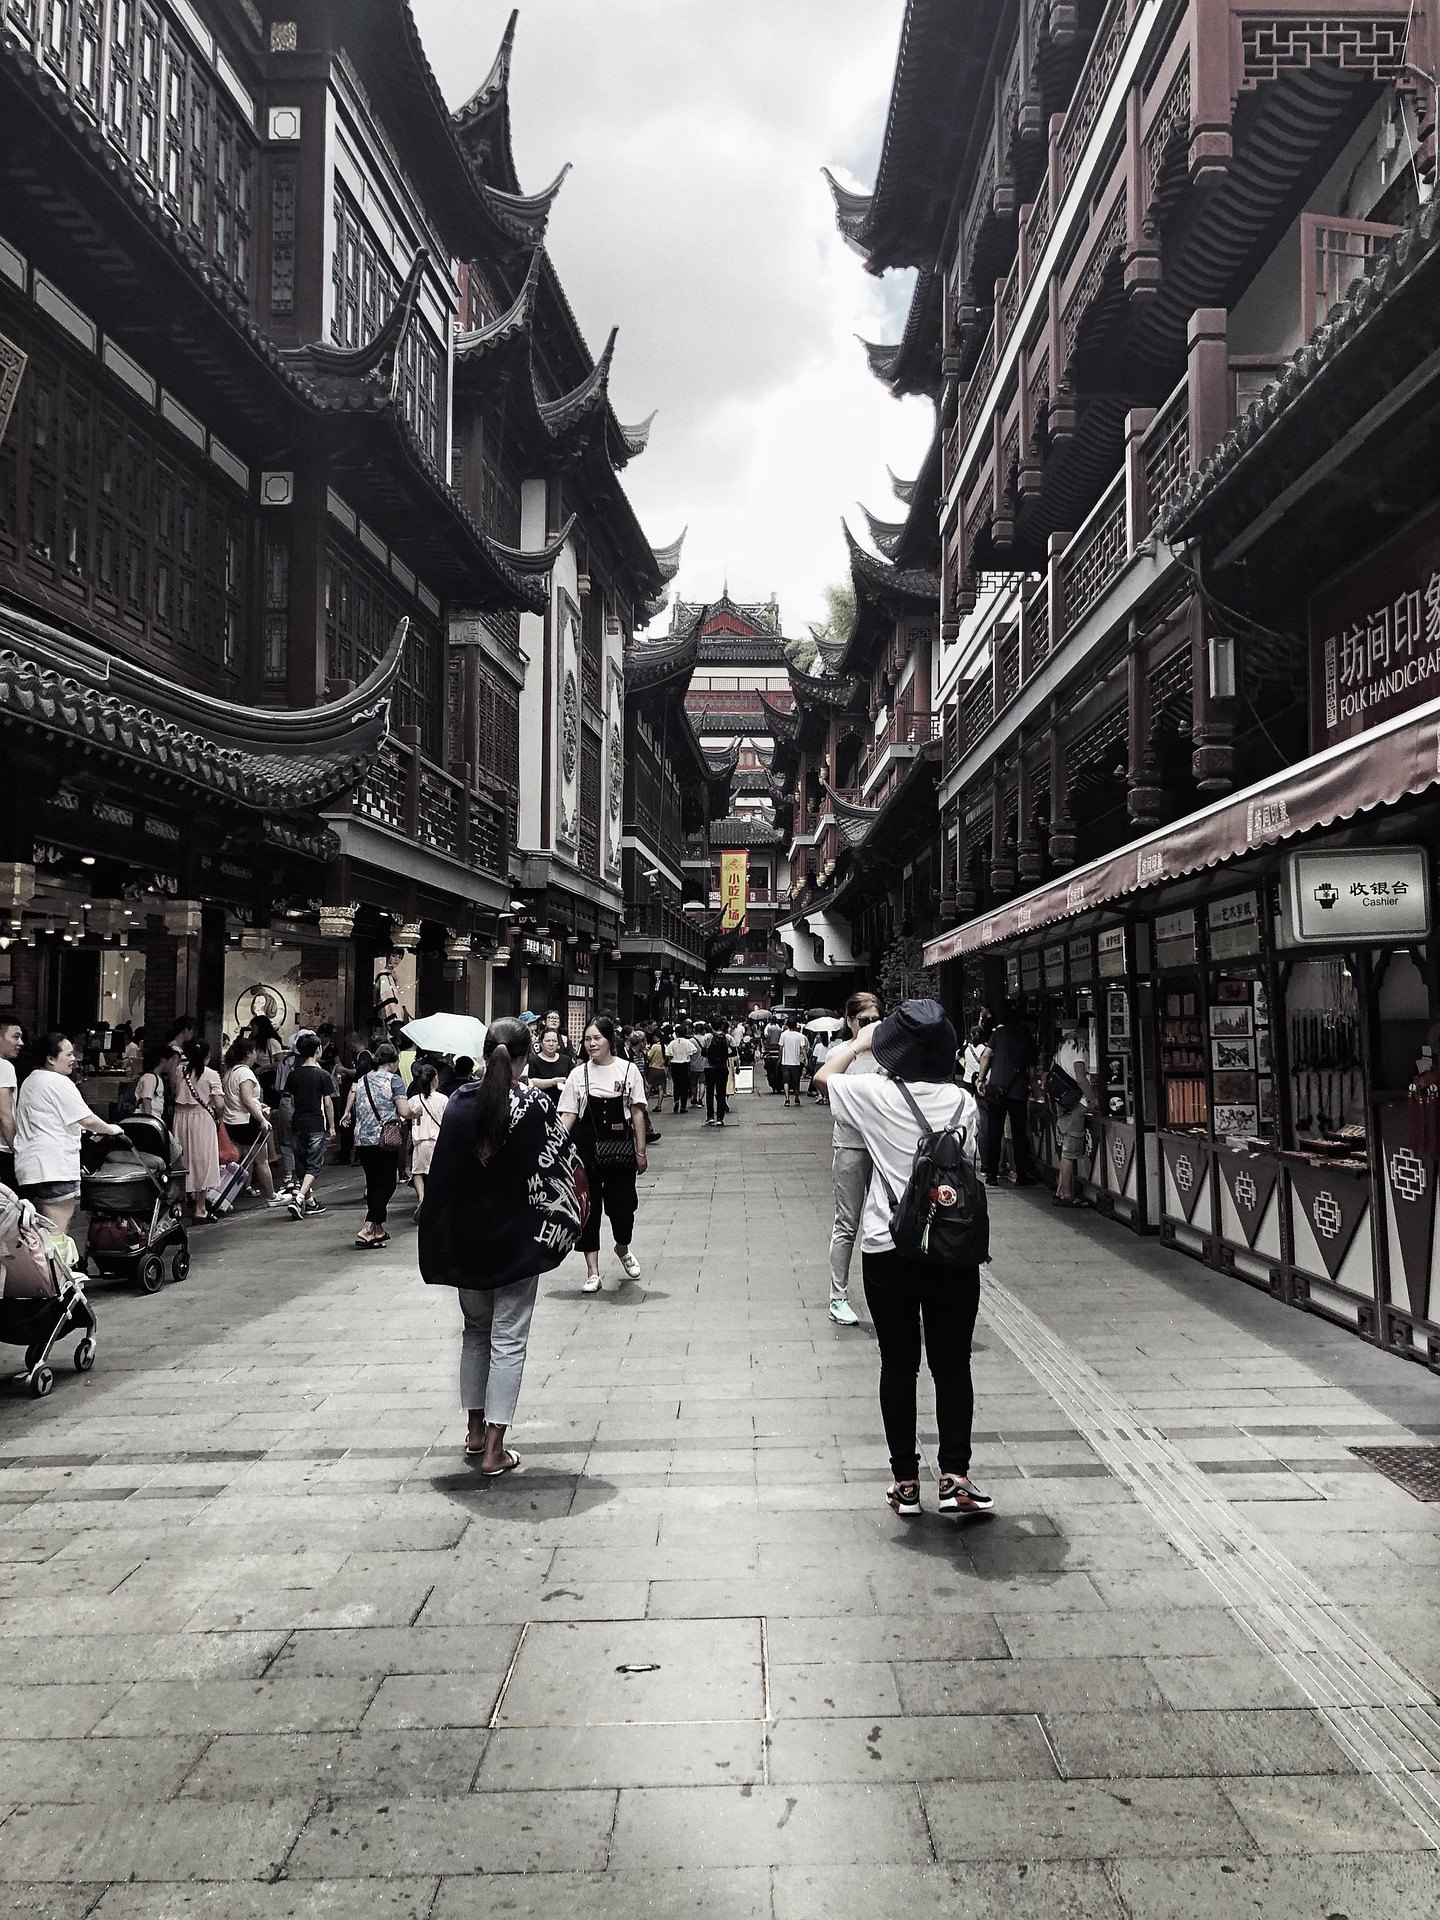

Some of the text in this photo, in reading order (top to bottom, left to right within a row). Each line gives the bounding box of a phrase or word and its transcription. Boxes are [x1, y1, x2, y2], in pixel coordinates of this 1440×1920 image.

[1340, 686, 1367, 720] FOLK
[728, 873, 741, 921] 小吃广场
[1349, 881, 1409, 897] 收银台
[1362, 897, 1399, 907] Cashier
